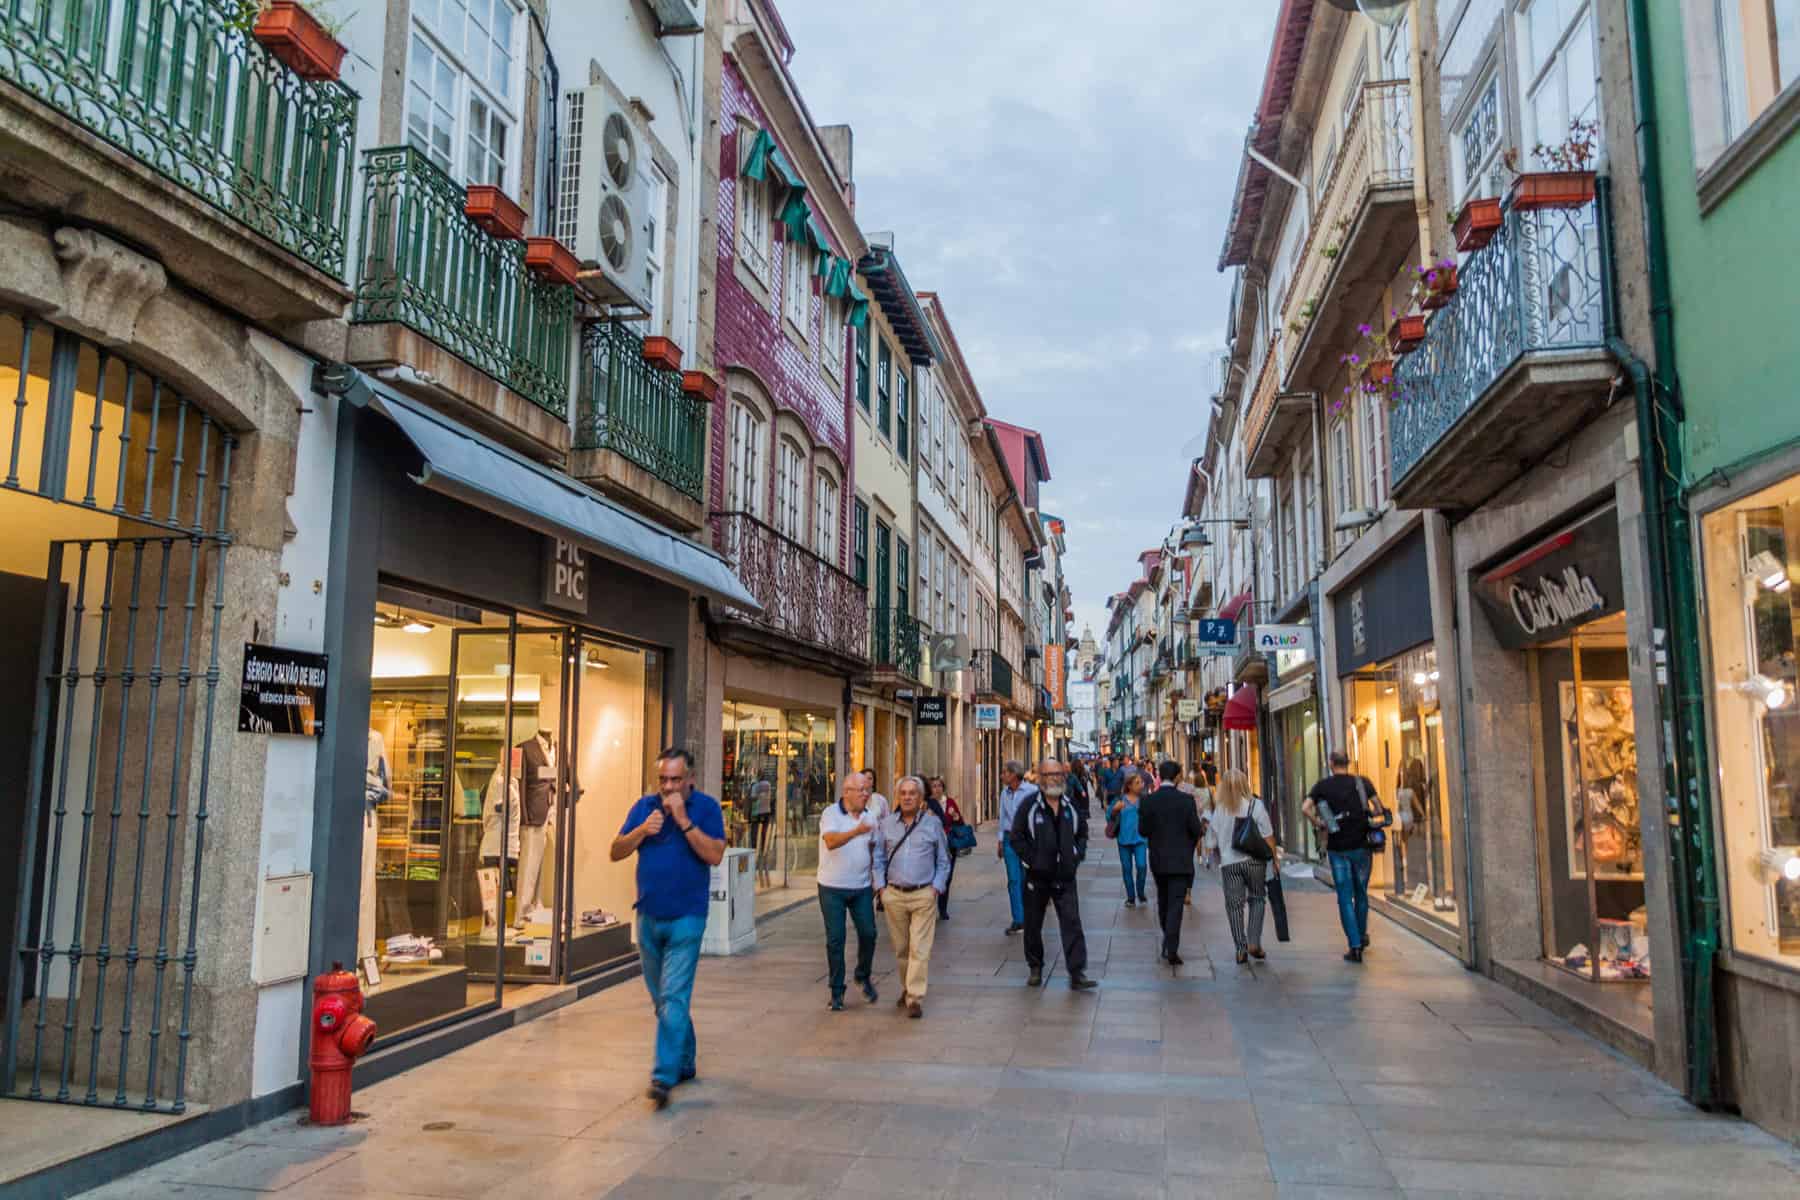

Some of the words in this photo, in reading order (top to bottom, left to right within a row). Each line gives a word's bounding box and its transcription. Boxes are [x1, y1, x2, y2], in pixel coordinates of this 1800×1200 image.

[556, 537, 585, 567] PIC
[555, 562, 585, 600] PIC
[246, 656, 272, 681] SÉRGIO
[309, 667, 326, 688] MELO
[920, 711, 943, 720] things
[923, 703, 940, 711] nice
